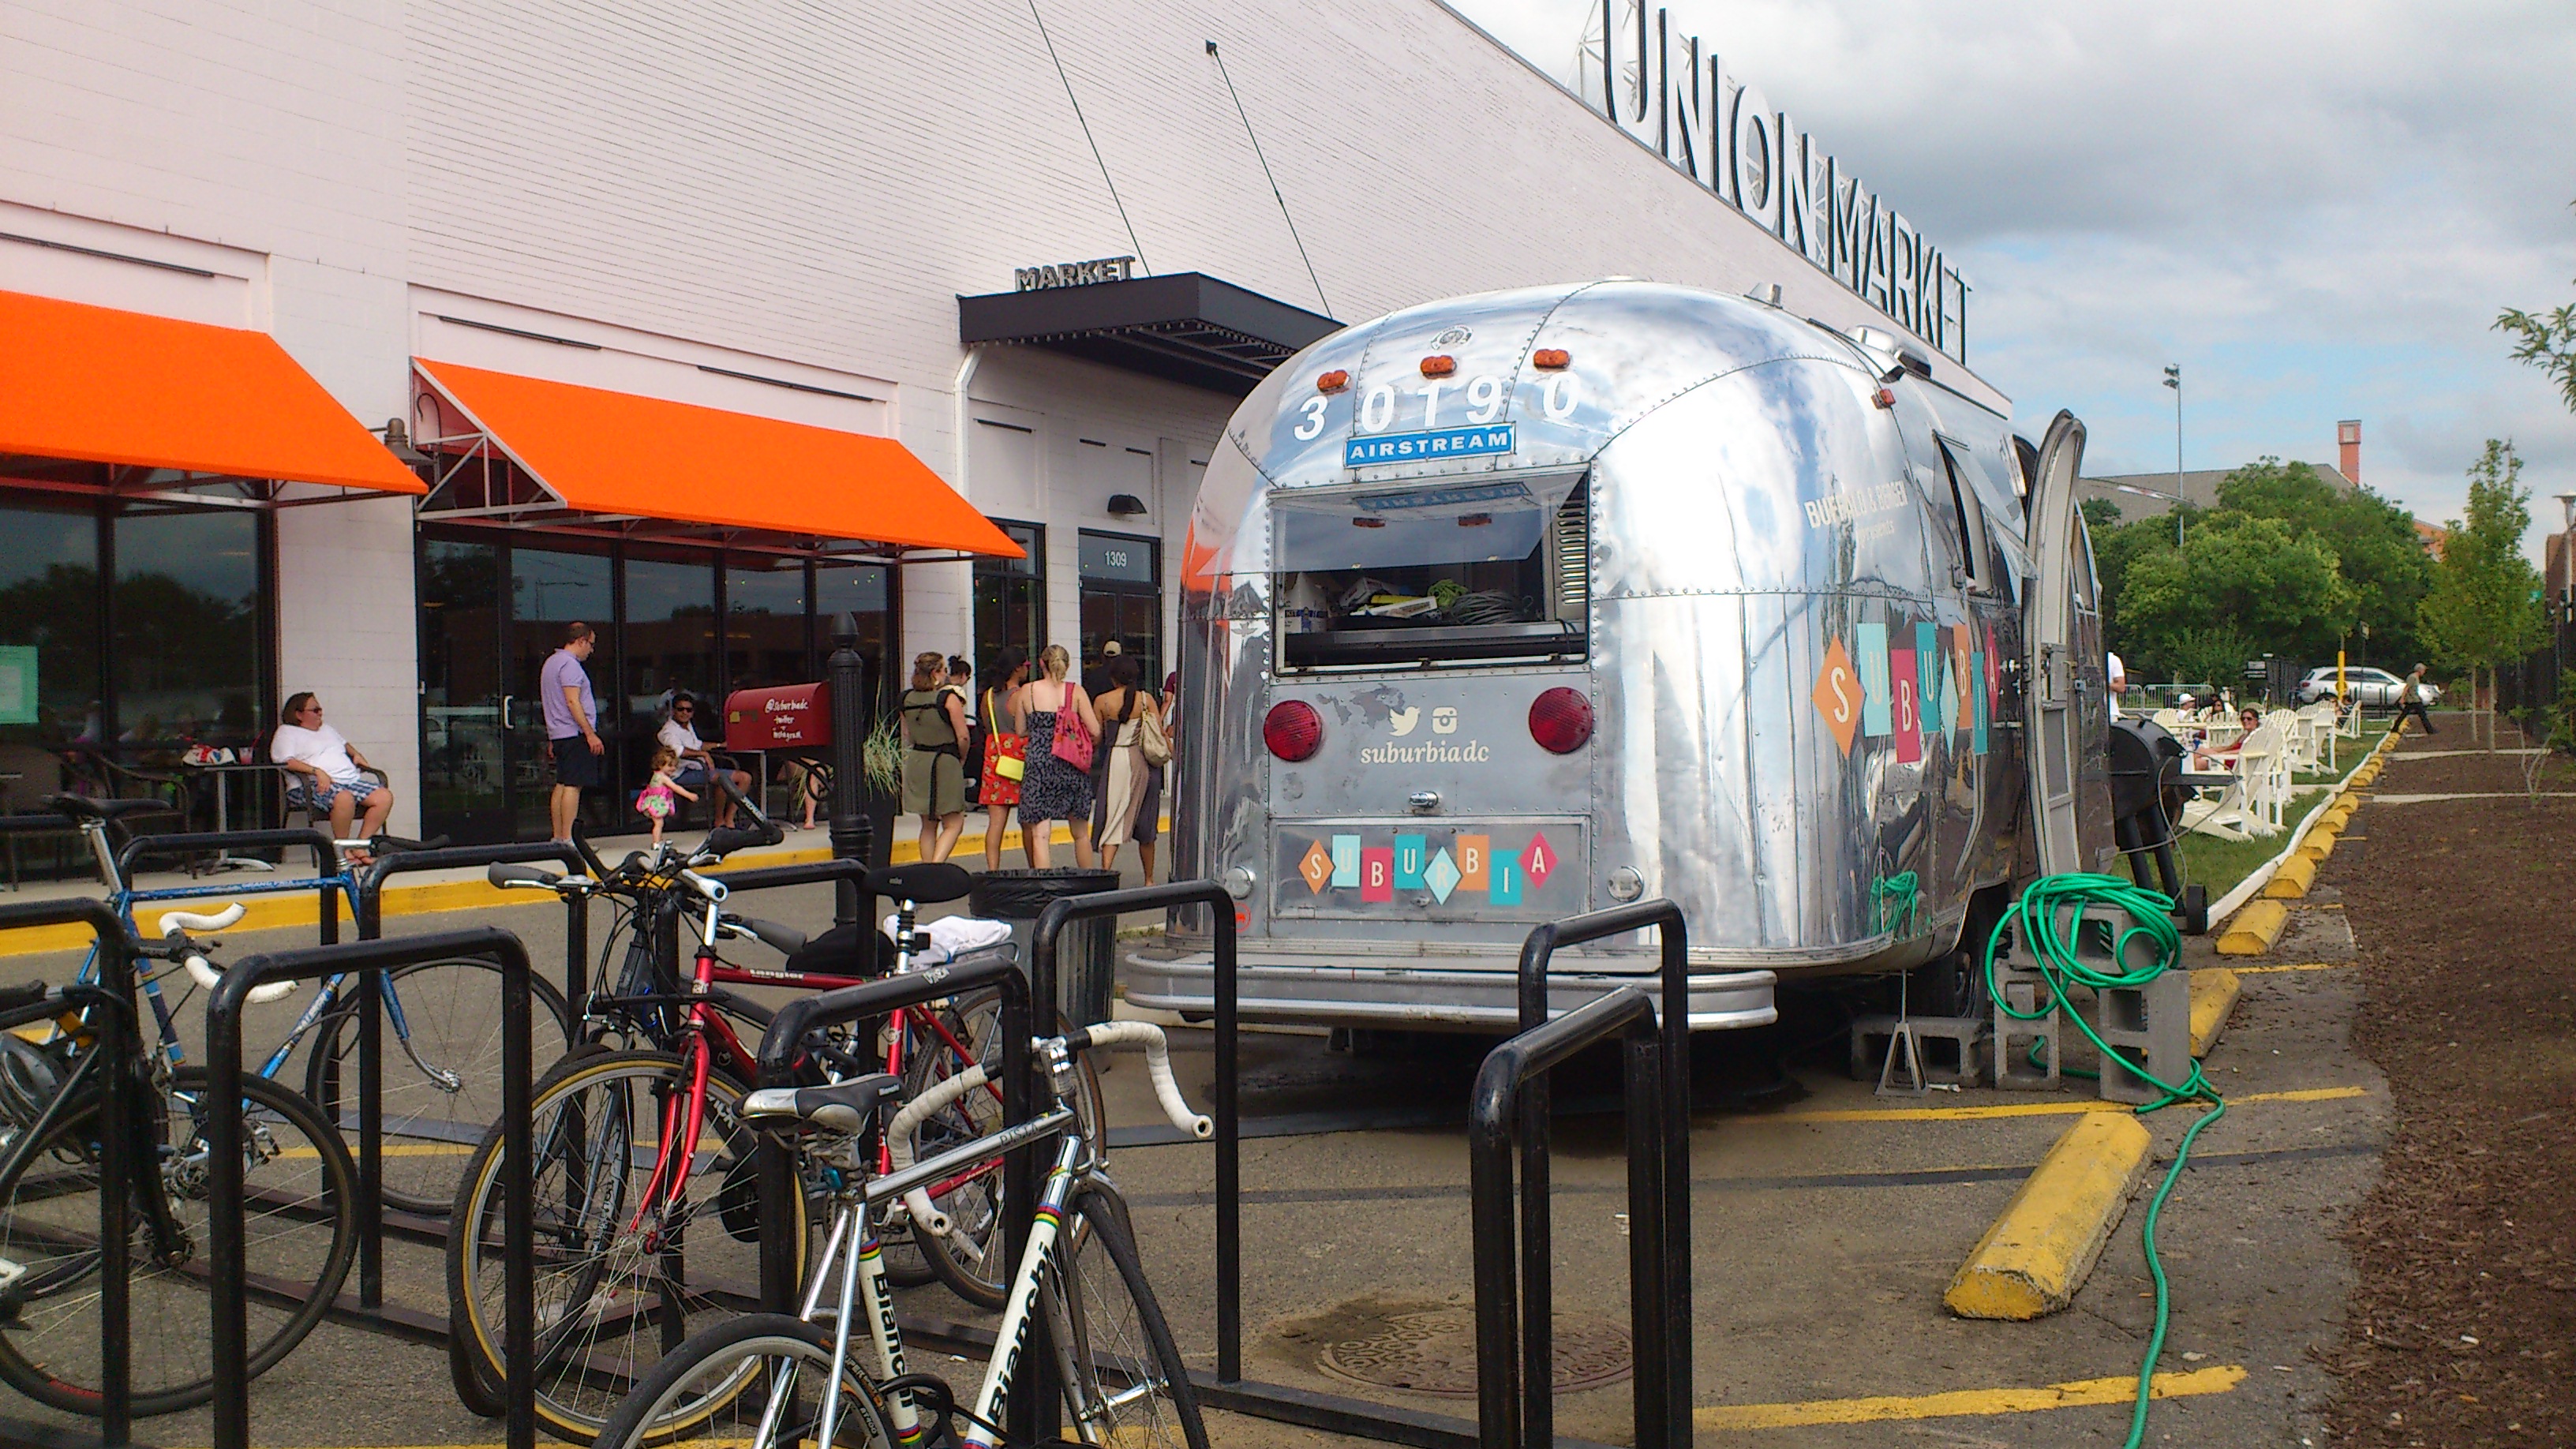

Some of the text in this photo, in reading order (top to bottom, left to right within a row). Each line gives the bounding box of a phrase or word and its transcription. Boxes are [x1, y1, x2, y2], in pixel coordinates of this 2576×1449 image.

[1604, 0, 1972, 366] UNION MARKET
[1015, 256, 1136, 291] MARKET
[1294, 372, 1579, 442] 30190
[1350, 431, 1508, 460] AIRSTREAM
[1804, 489, 1867, 529] BUFFALO
[1105, 551, 1127, 567] 1309
[1830, 646, 1997, 733] SUBURBIA
[1361, 739, 1490, 764] suburbiadc
[1310, 846, 1546, 893] SUBURBIA
[987, 1241, 1053, 1427] Bianchi
